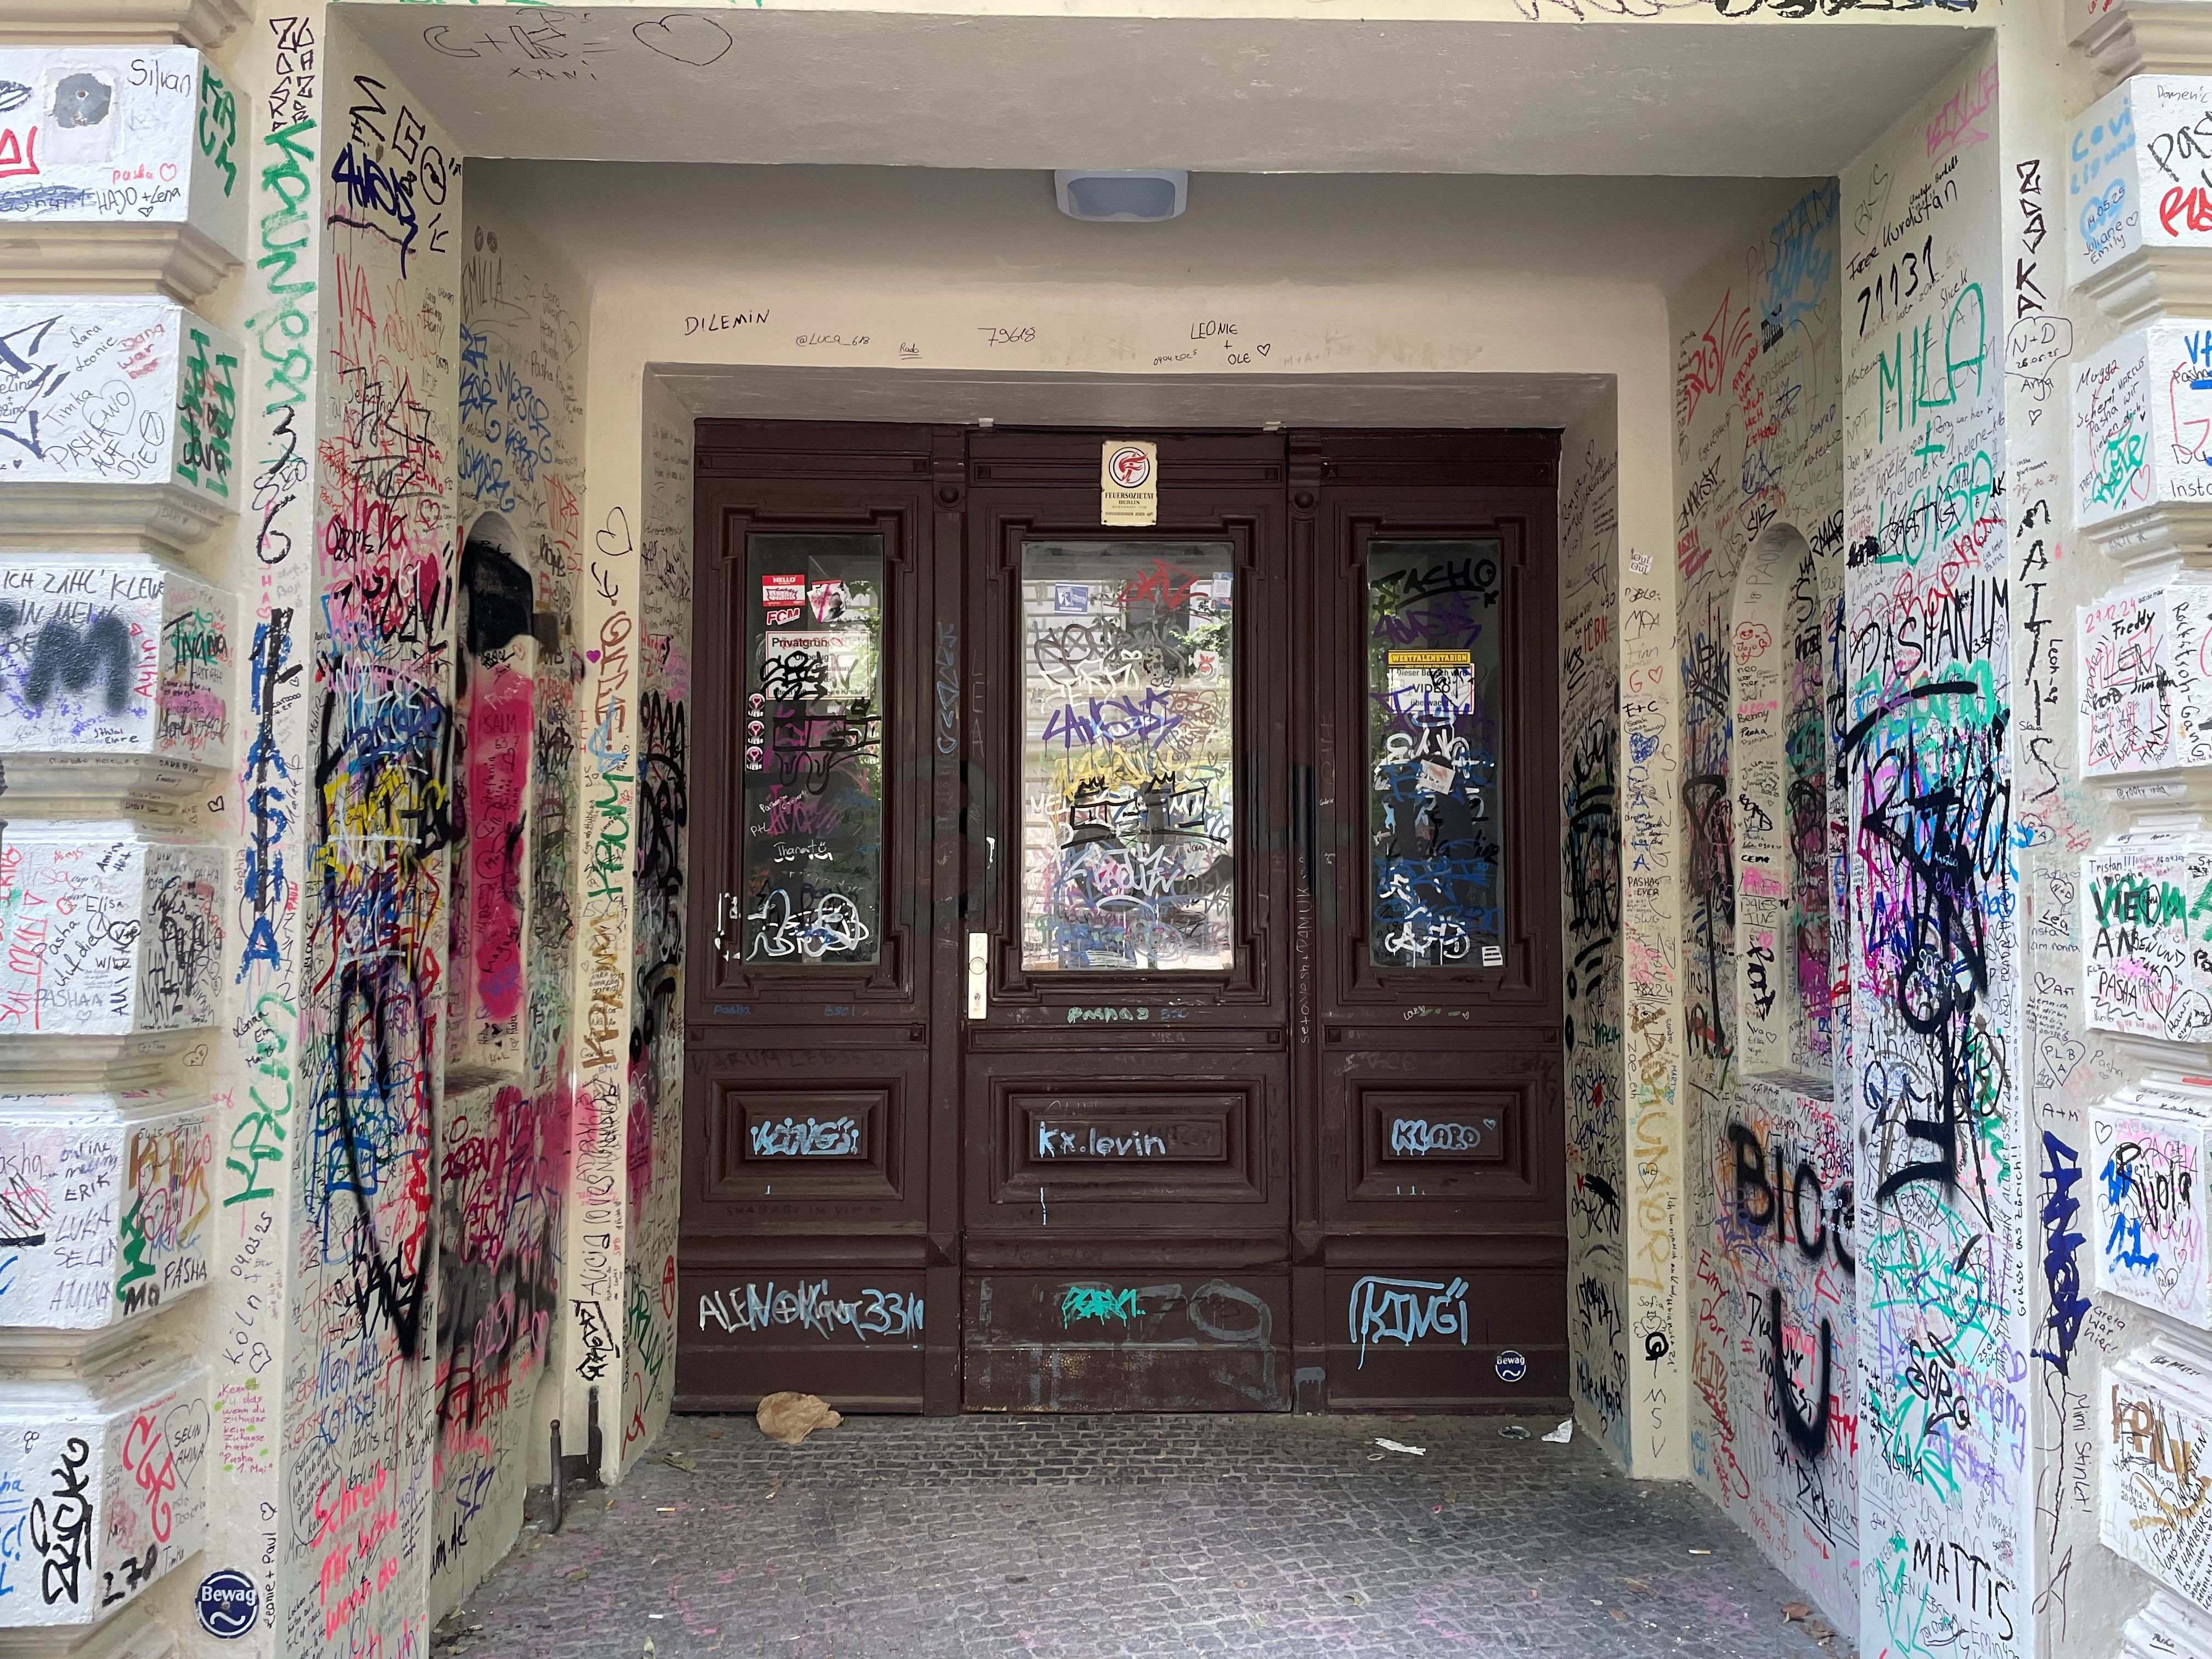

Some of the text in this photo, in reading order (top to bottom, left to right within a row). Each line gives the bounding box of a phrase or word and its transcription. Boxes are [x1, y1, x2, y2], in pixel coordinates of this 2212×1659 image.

[767, 608, 800, 625] FCM
[1392, 654, 1467, 662] WESTFALENSTADION
[1413, 684, 1451, 693] VIDEO
[1496, 1355, 1526, 1366] Bewag
[201, 1585, 258, 1605] Bewag
[1912, 1537, 2013, 1640] MATTIS
